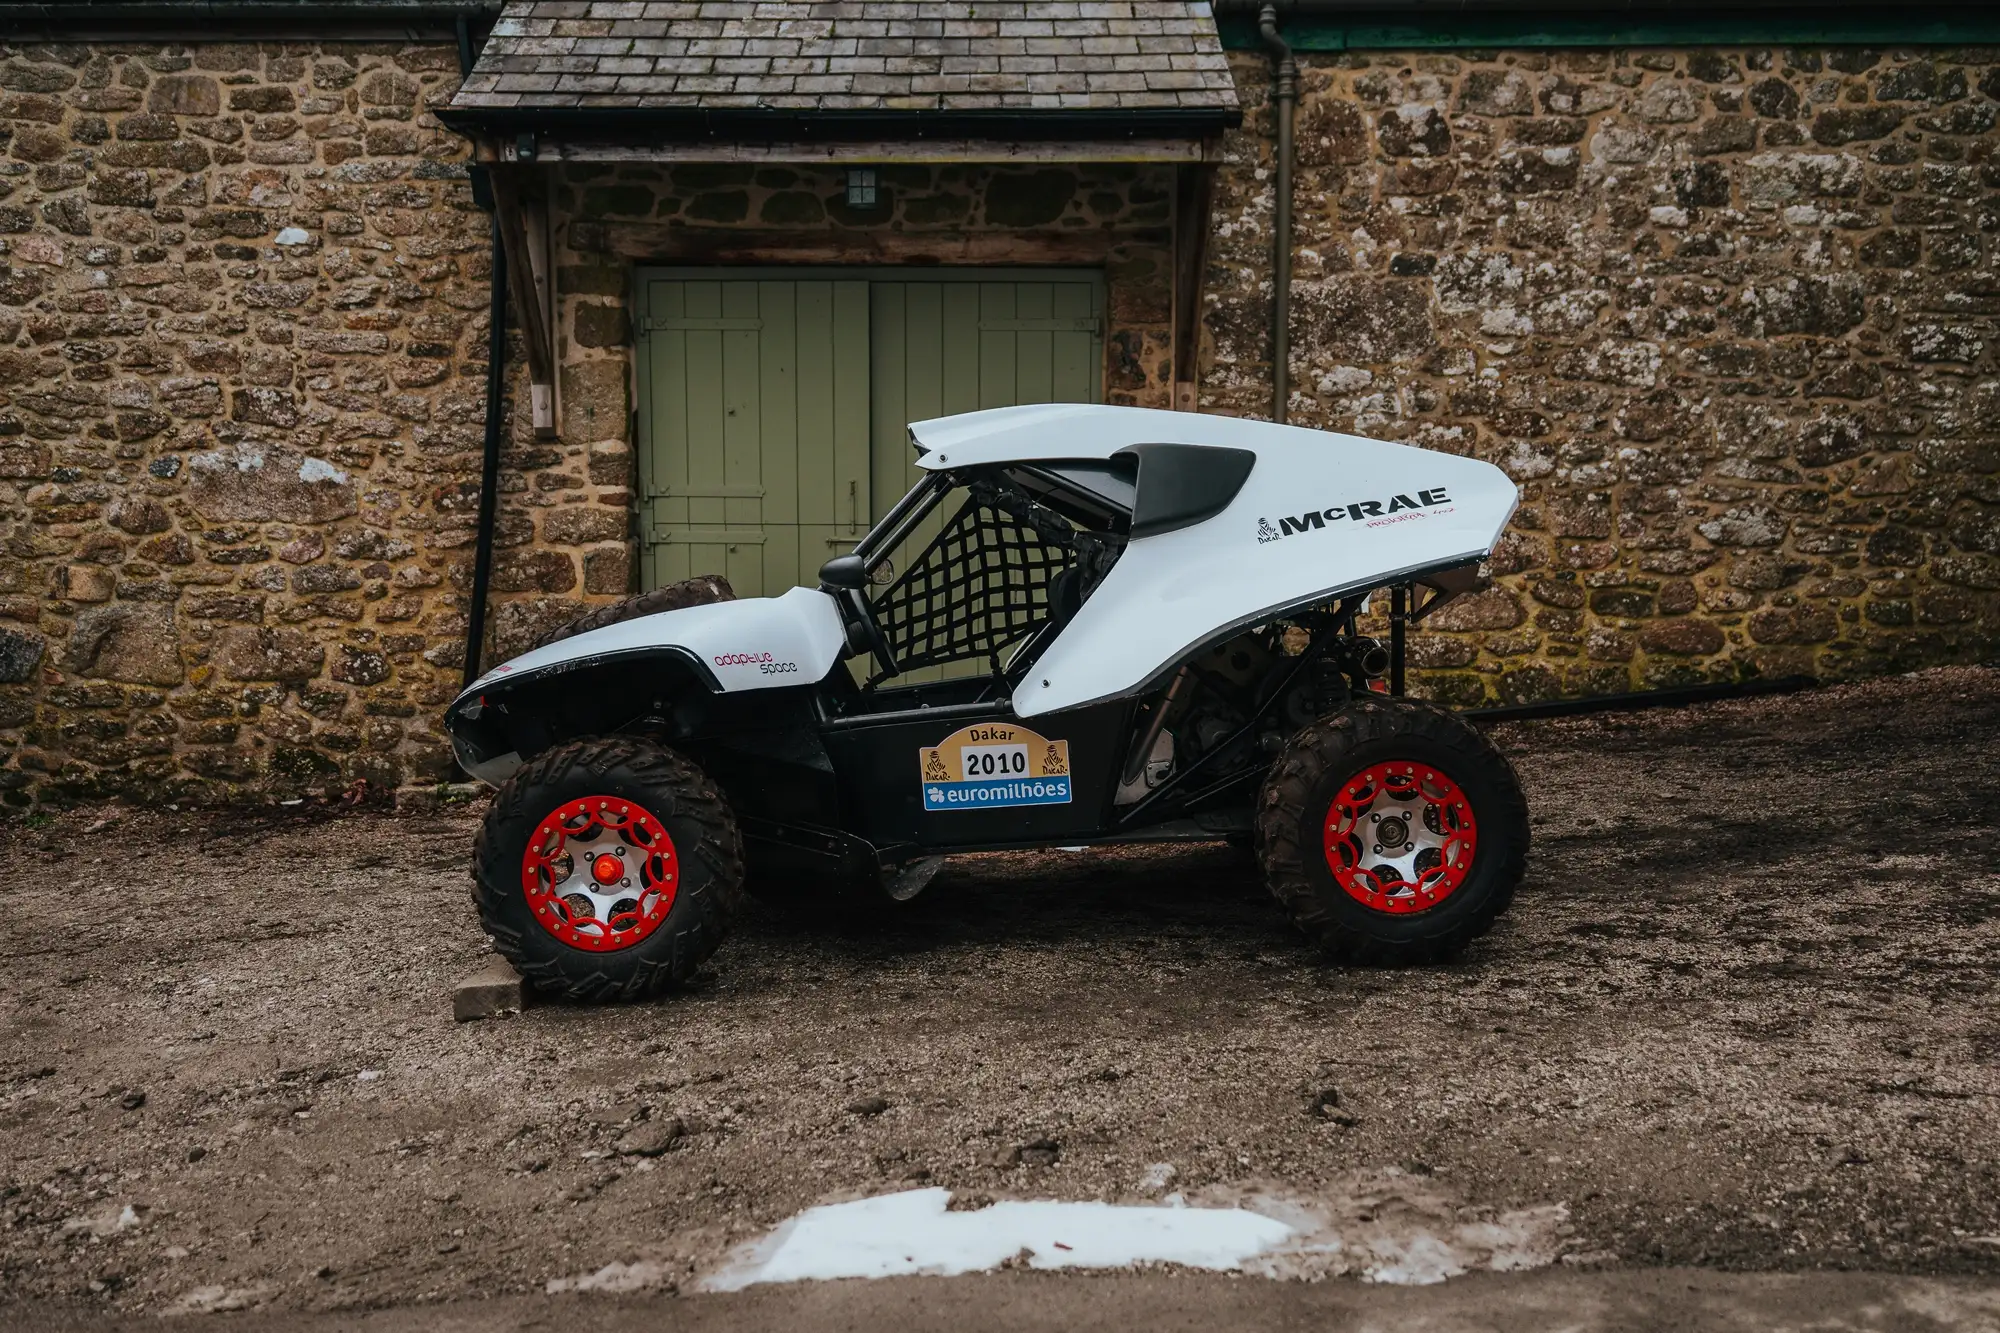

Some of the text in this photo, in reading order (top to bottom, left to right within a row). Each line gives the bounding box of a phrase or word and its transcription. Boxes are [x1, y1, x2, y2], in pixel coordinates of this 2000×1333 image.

[1257, 532, 1282, 545] DAKAR
[714, 652, 773, 667] adaptive
[760, 662, 798, 676] space
[969, 727, 1015, 742] Dakar
[967, 751, 1026, 776] 2010
[1042, 765, 1067, 775] DAKAR
[925, 771, 950, 781] DAKAR
[947, 782, 1067, 803] euromilhões
